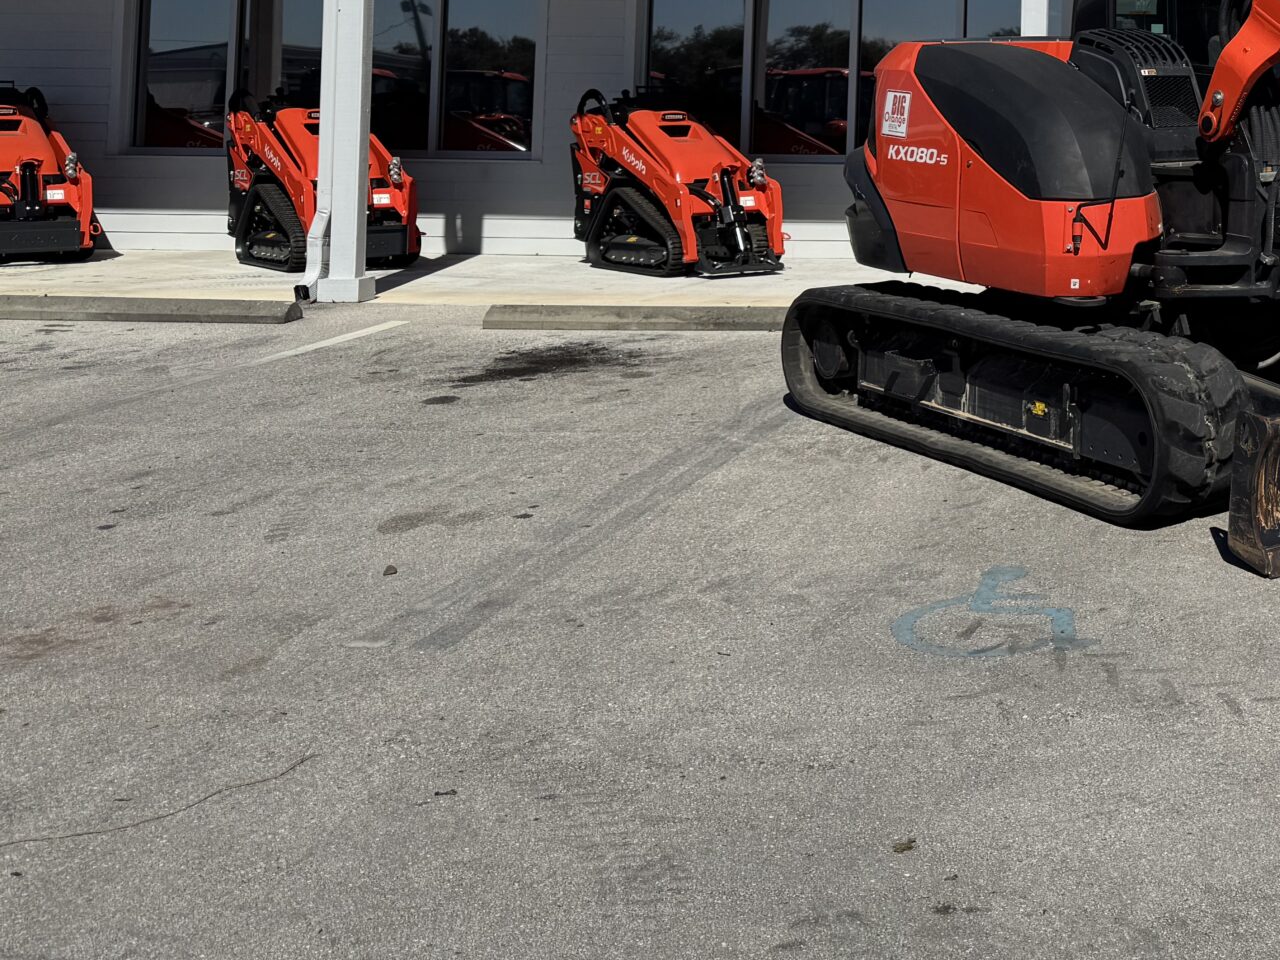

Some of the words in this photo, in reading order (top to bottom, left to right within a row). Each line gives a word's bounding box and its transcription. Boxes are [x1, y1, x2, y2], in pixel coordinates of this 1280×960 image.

[892, 94, 906, 116] BIG
[885, 112, 906, 127] Orange
[264, 144, 282, 172] Kubota
[622, 146, 646, 175] Kubota
[583, 173, 601, 184] SCL
